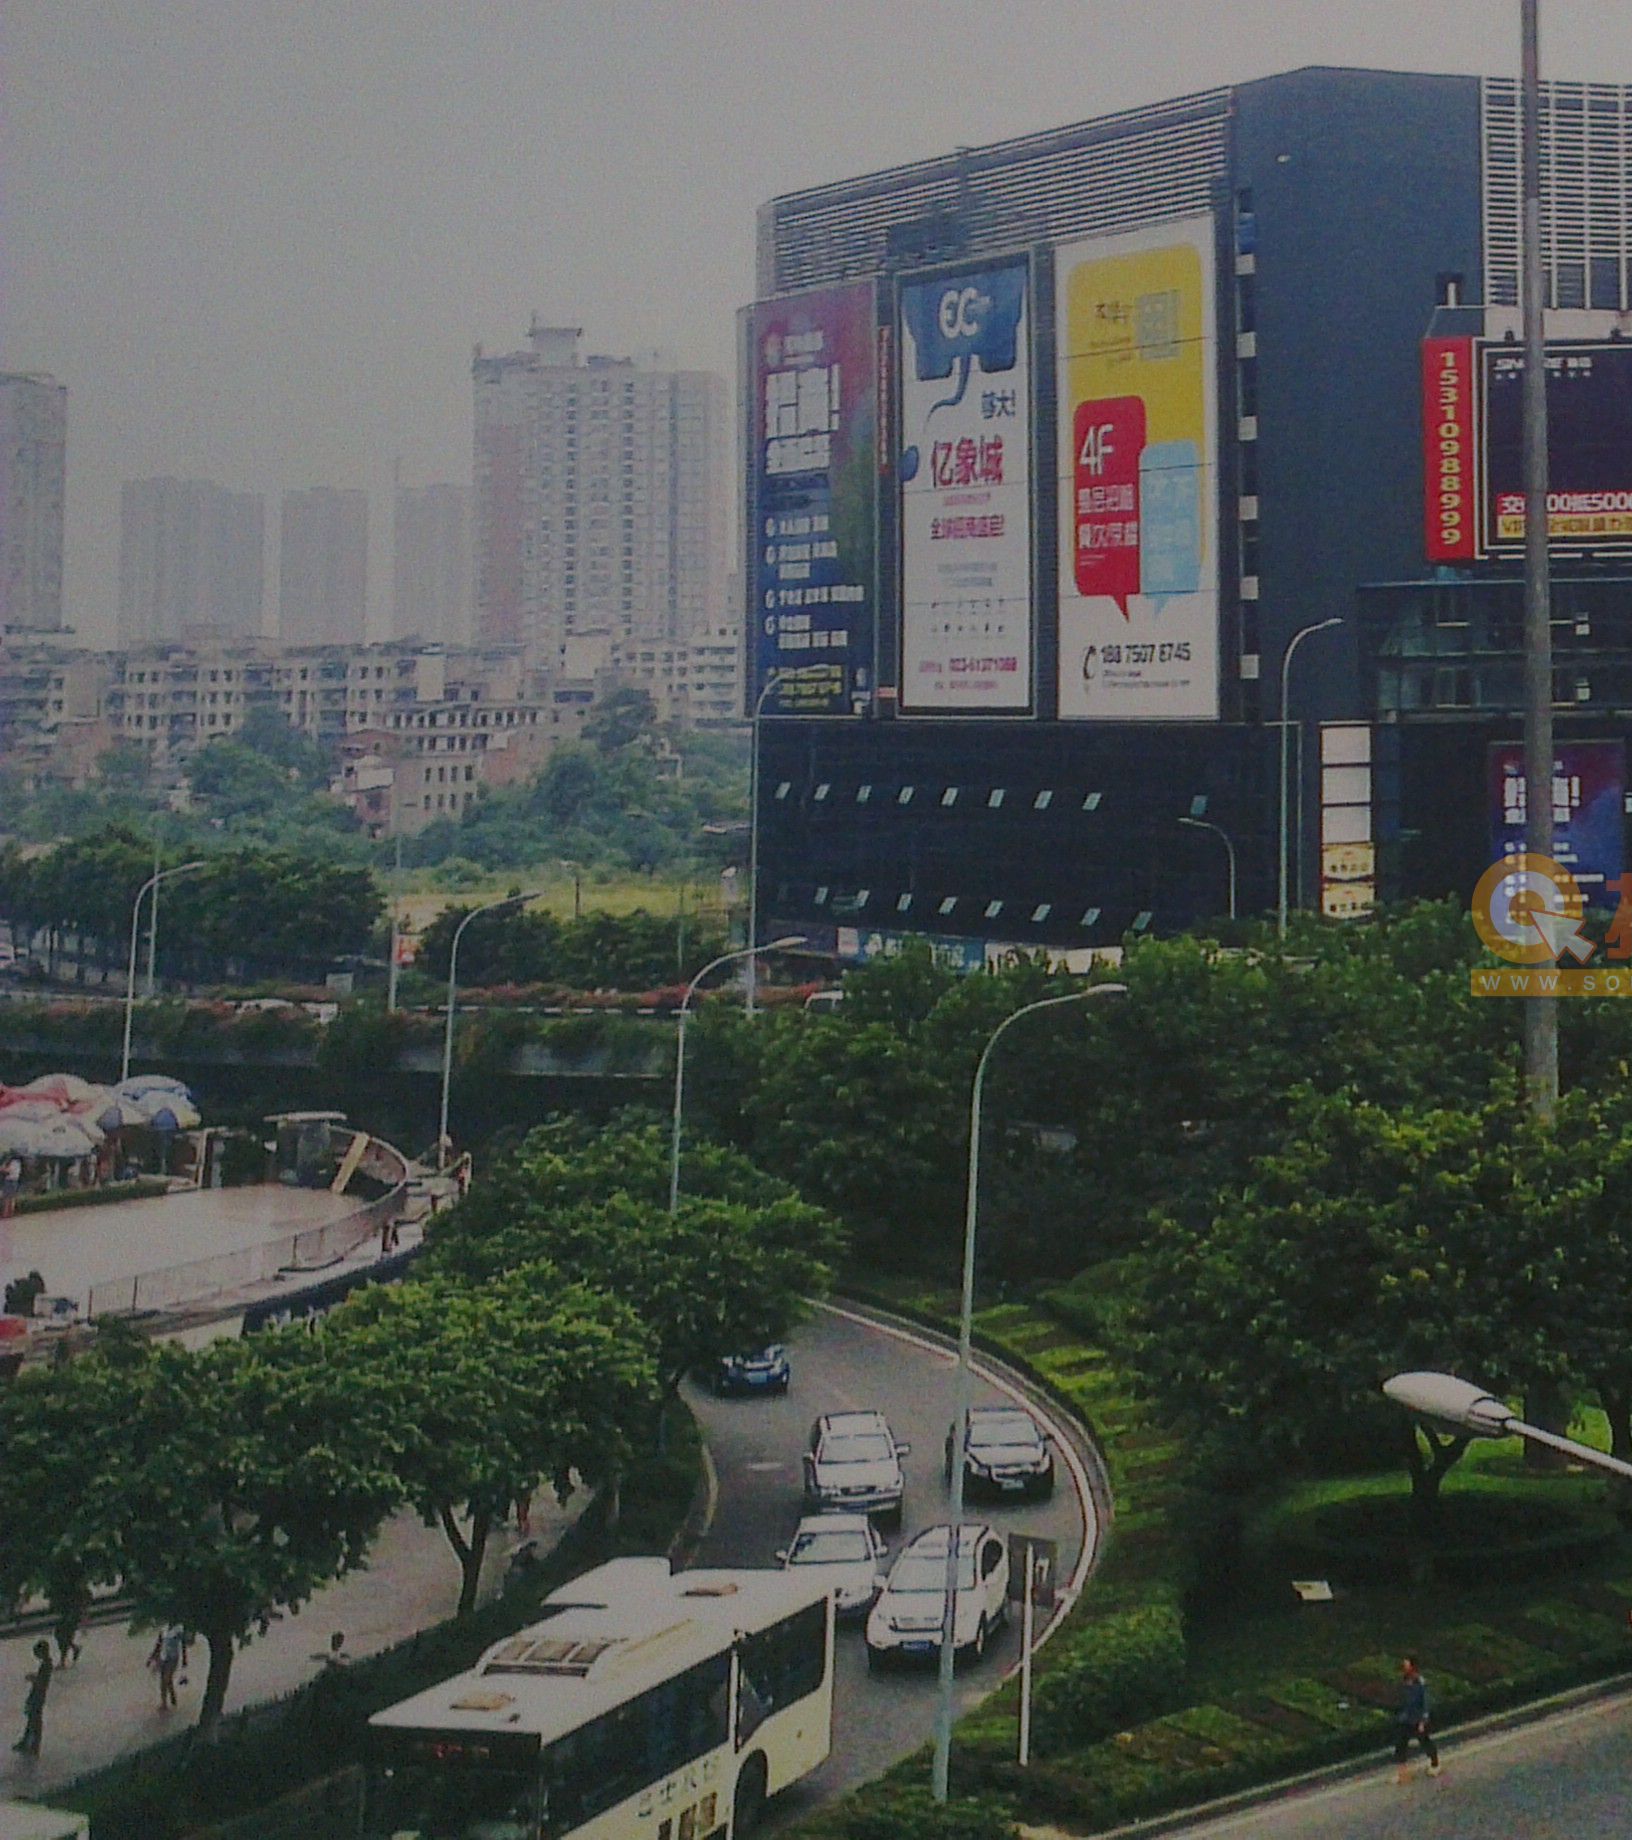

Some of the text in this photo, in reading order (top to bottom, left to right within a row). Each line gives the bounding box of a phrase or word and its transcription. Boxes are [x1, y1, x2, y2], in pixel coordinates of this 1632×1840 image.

[930, 434, 1004, 489] 亿象城
[1079, 423, 1115, 476] 4F
[1438, 350, 1462, 545] 15310988999
